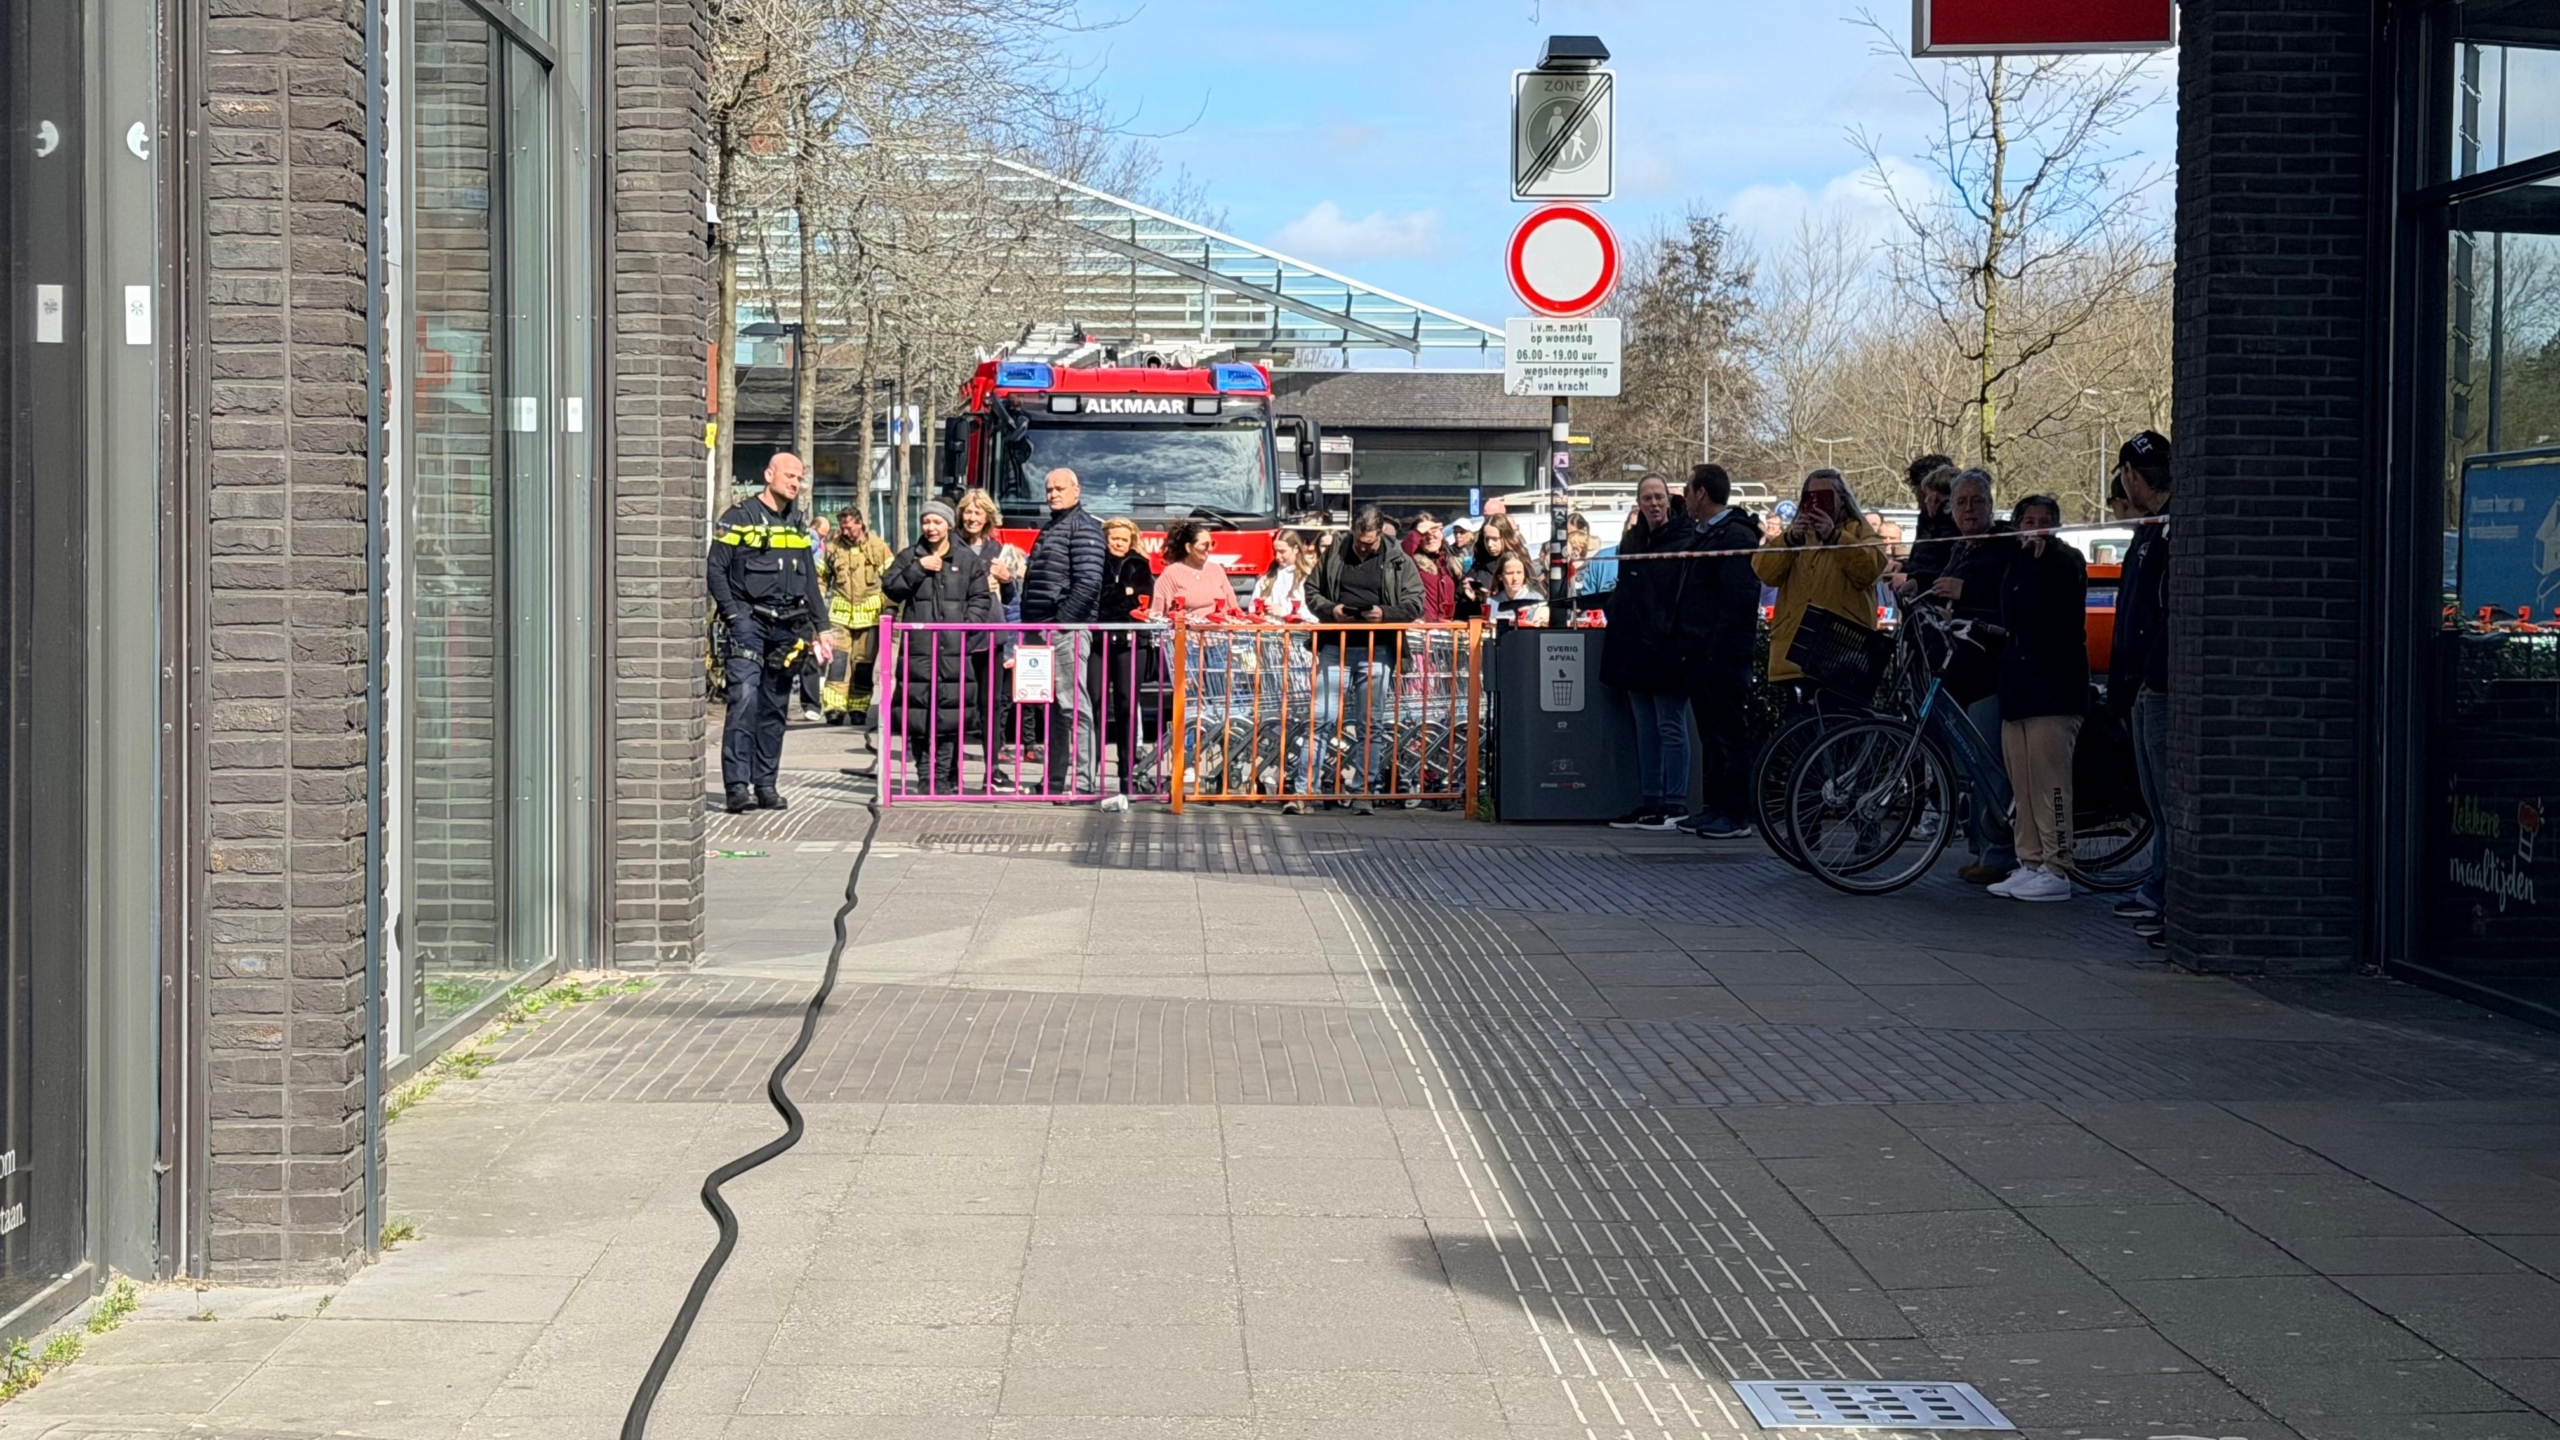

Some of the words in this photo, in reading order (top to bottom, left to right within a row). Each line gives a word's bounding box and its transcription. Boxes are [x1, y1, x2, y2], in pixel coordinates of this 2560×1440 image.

[1544, 80, 1585, 92] ZONE
[1530, 322, 1557, 333] i.v.m.
[1560, 322, 1588, 333] markt
[1530, 335, 1542, 345] op
[1545, 333, 1593, 345] woensdag
[1516, 349, 1543, 360] 06.00
[1553, 349, 1579, 360] 19.00
[1581, 351, 1598, 360] uur
[1524, 366, 1608, 378] wegsleepregeling
[1537, 382, 1554, 391] van
[1558, 381, 1589, 391] kracht
[1085, 398, 1185, 414] ALKMAAR
[1546, 645, 1579, 653] OVERIG
[1548, 654, 1577, 662] AFVAL
[2053, 787, 2065, 827] REBEL
[2450, 848, 2537, 913] maaltijden
